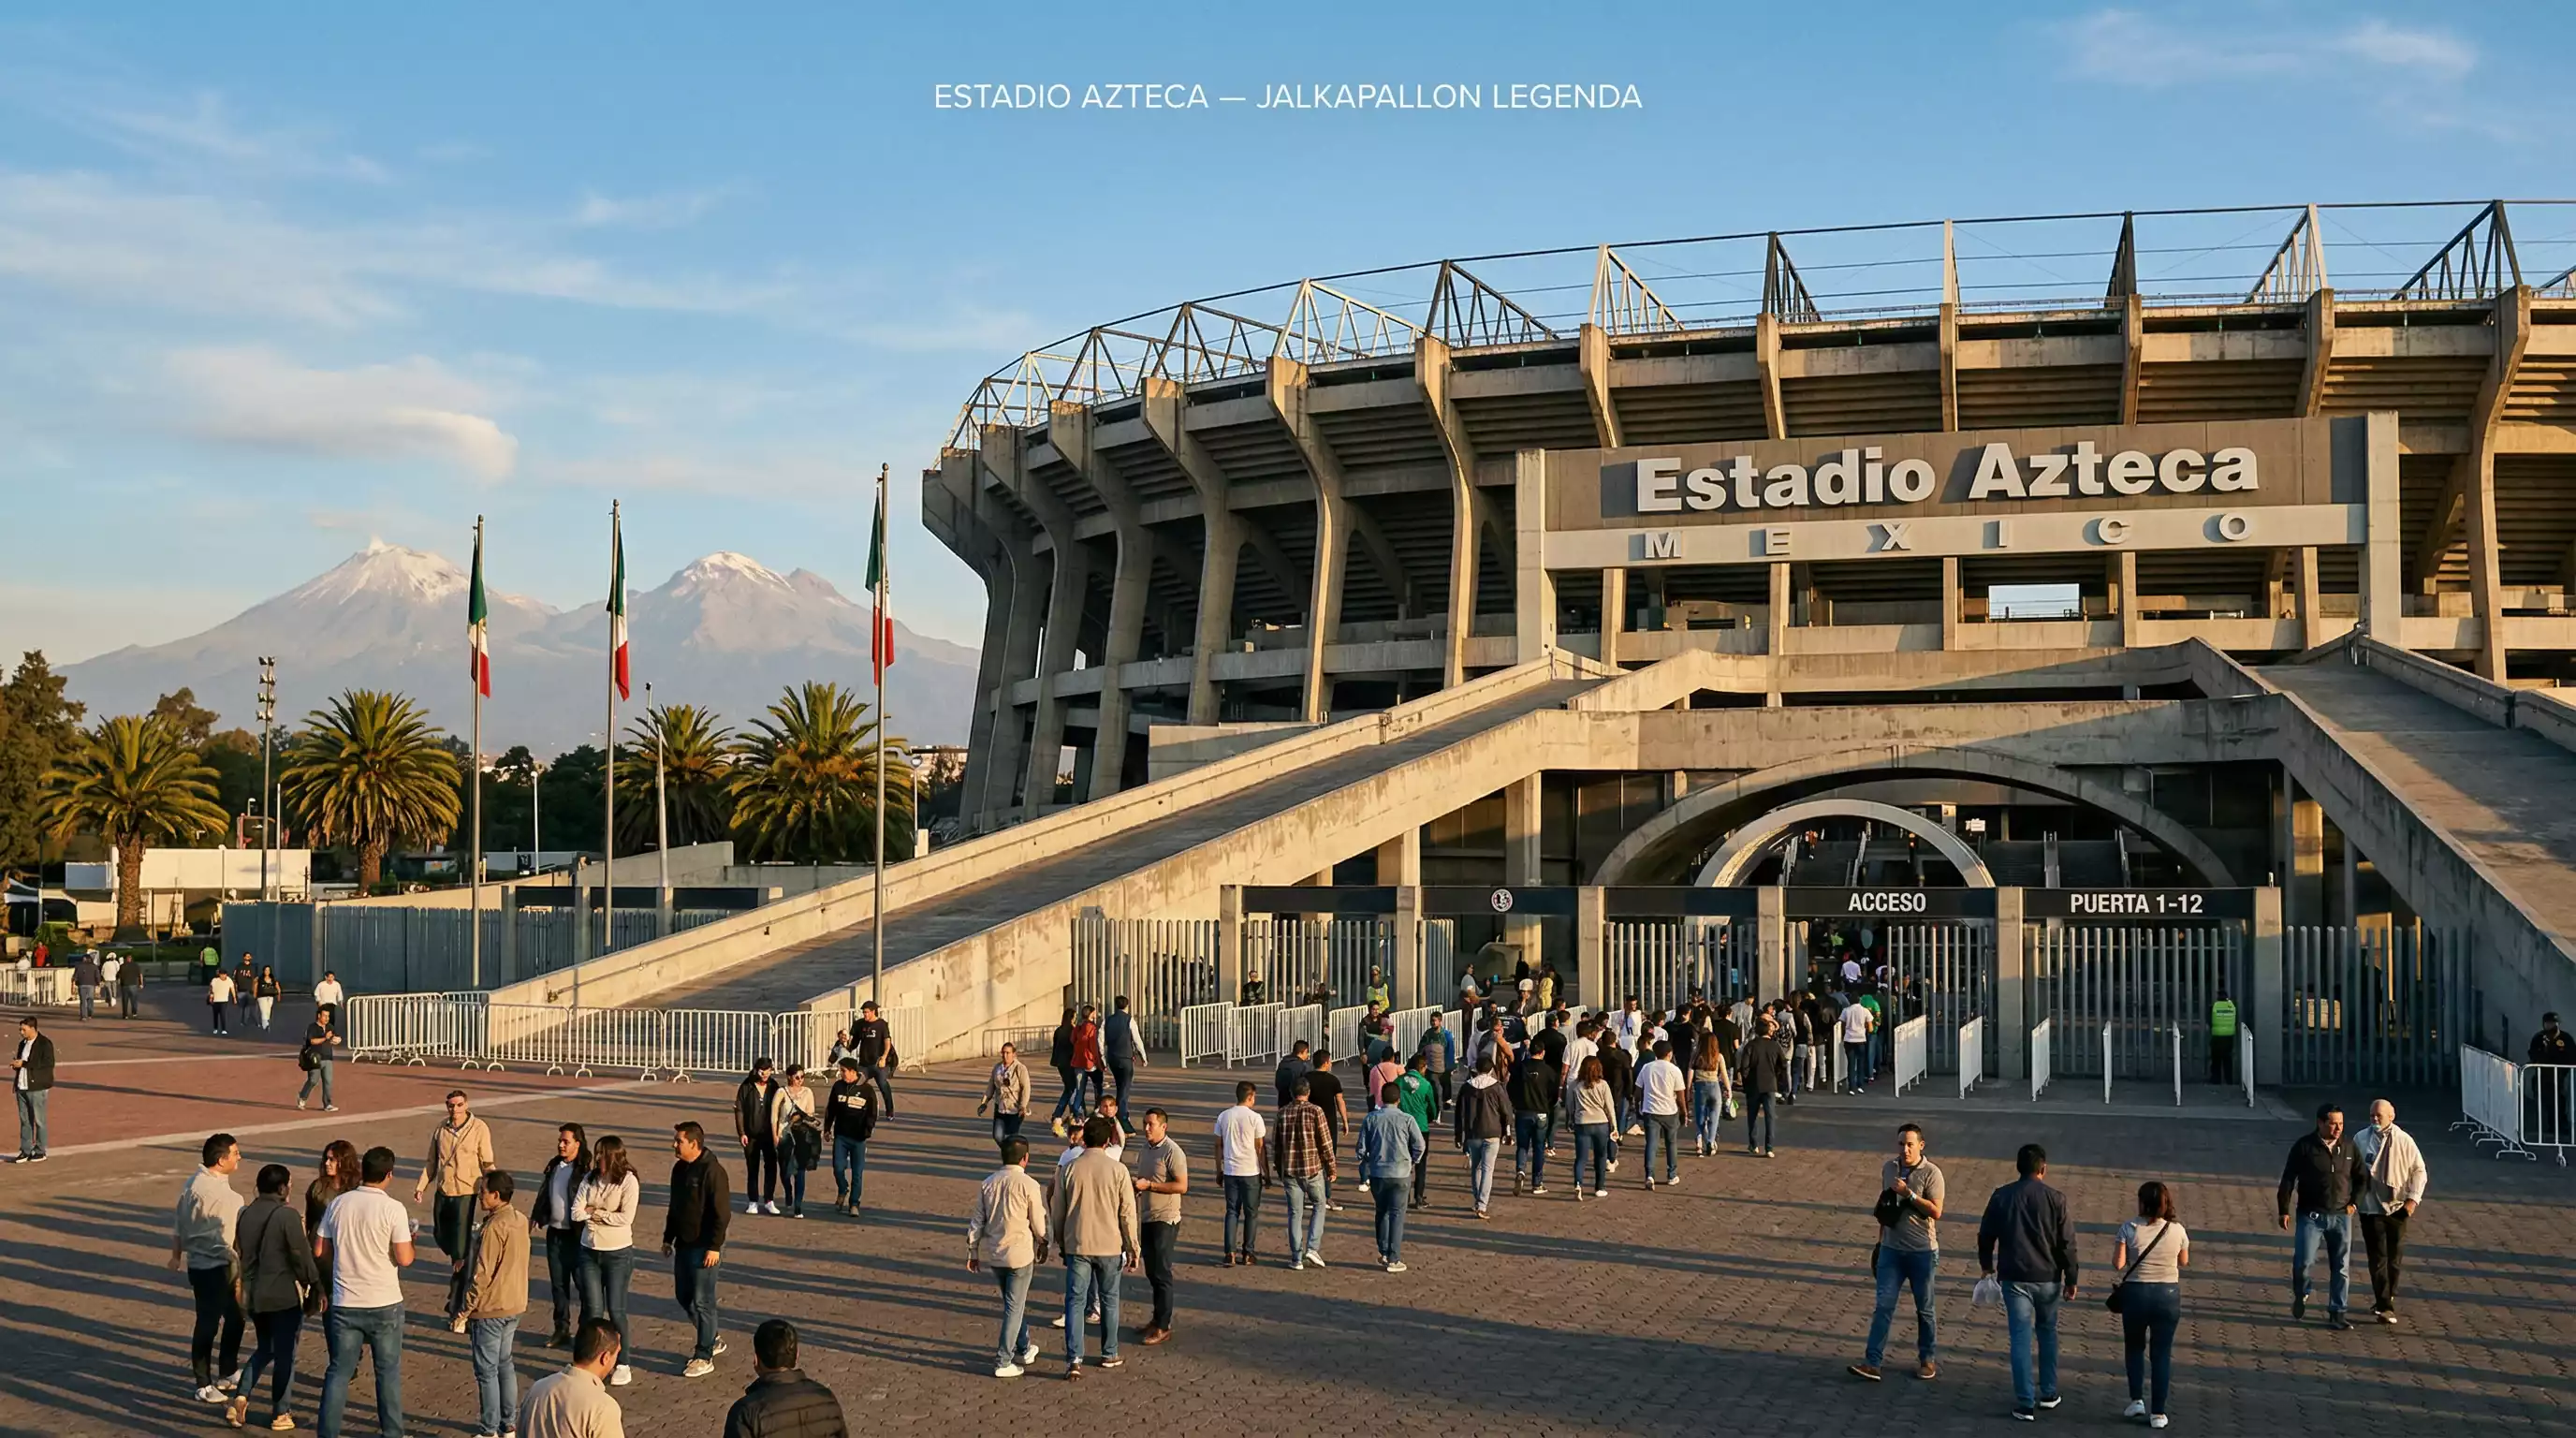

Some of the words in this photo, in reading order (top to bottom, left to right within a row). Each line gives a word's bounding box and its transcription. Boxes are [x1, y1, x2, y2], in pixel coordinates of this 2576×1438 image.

[1637, 446, 1937, 512] Estadio
[1968, 440, 2260, 500] Azteca
[1848, 892, 1926, 913] ACCESO
[2071, 893, 2150, 914] PUERTA
[2156, 893, 2203, 914] 1-12
